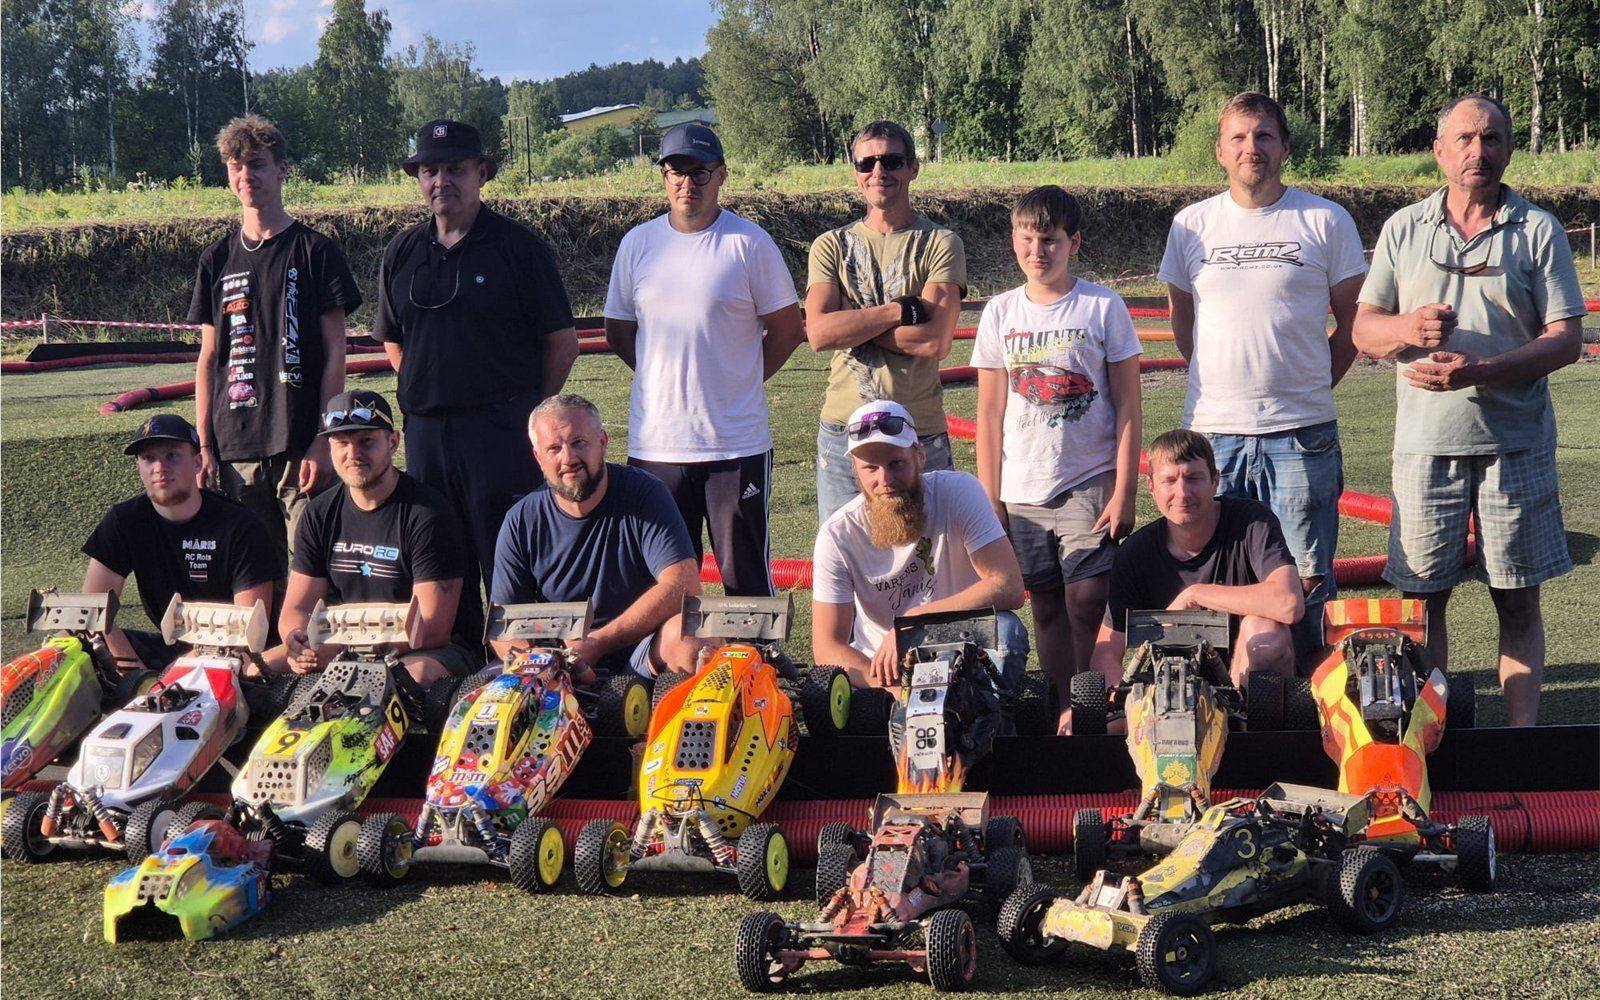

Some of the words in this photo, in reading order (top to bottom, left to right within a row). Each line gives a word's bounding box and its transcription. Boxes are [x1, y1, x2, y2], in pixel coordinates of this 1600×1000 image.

[185, 553, 196, 561] RC
[189, 561, 208, 569] Team
[390, 700, 406, 733] 9
[274, 732, 302, 754] 9
[1235, 828, 1256, 859] 3
